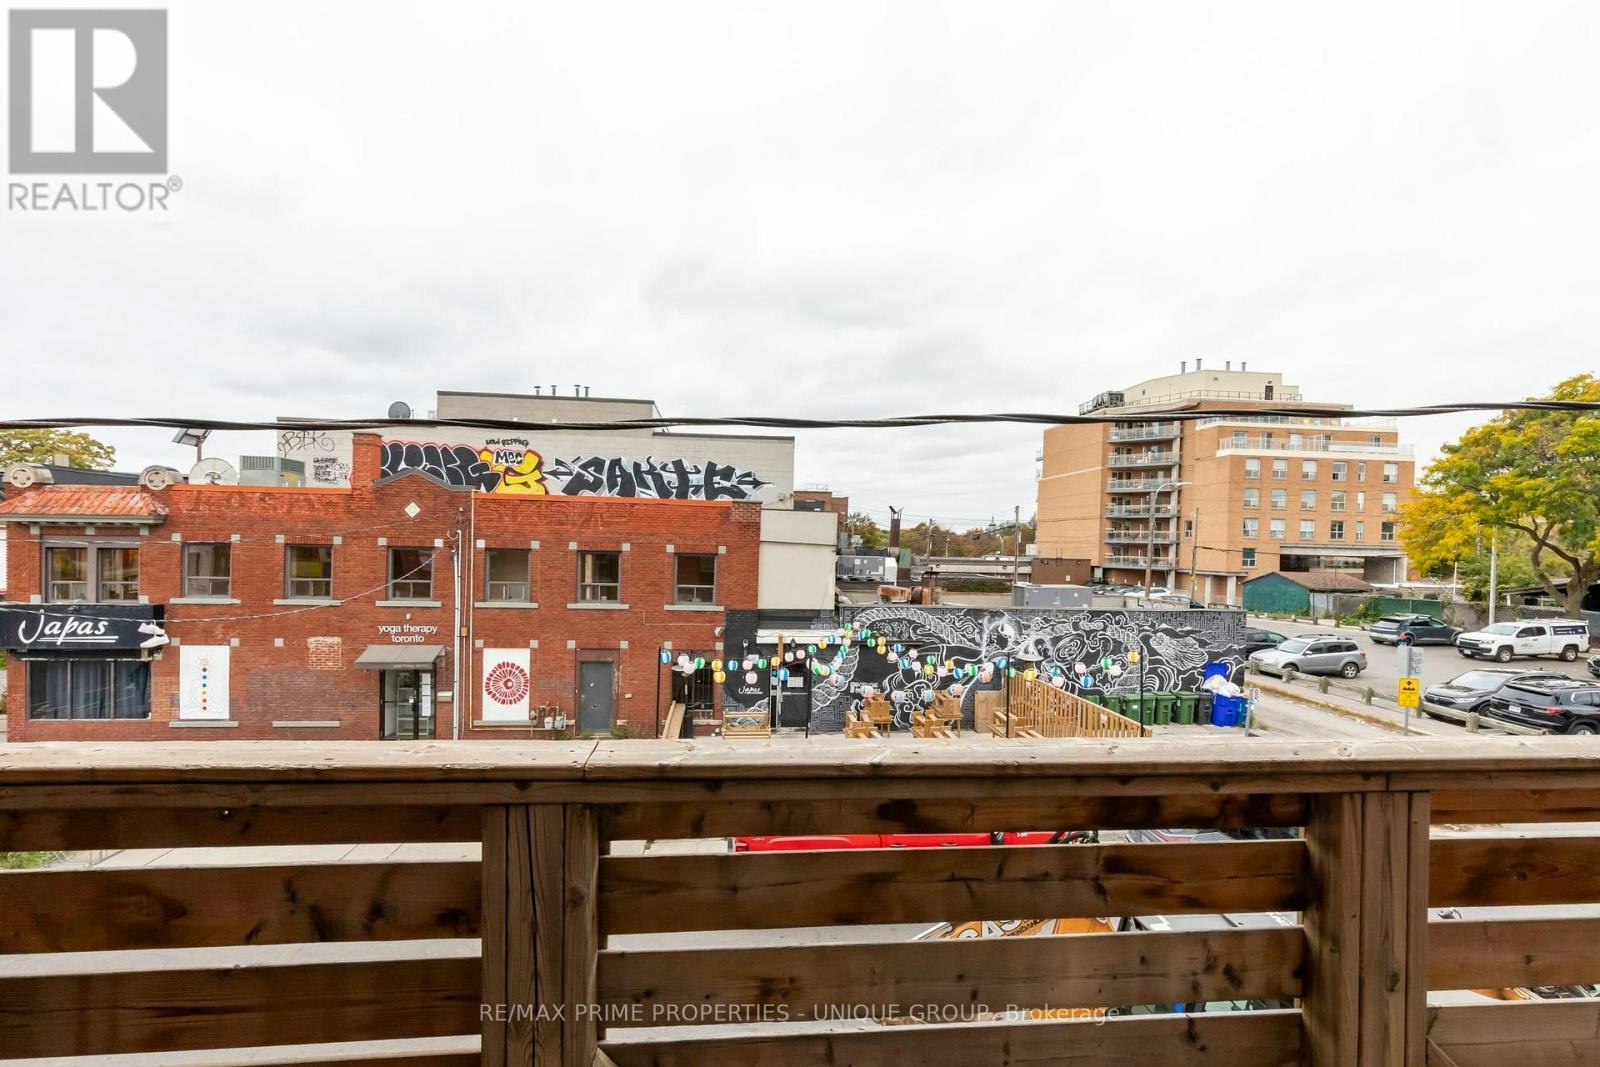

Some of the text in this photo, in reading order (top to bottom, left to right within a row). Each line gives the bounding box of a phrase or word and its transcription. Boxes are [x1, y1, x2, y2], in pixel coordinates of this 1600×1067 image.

[18, 609, 110, 645] Japas
[378, 623, 438, 634] yoga therapy
[391, 635, 425, 643] toronto
